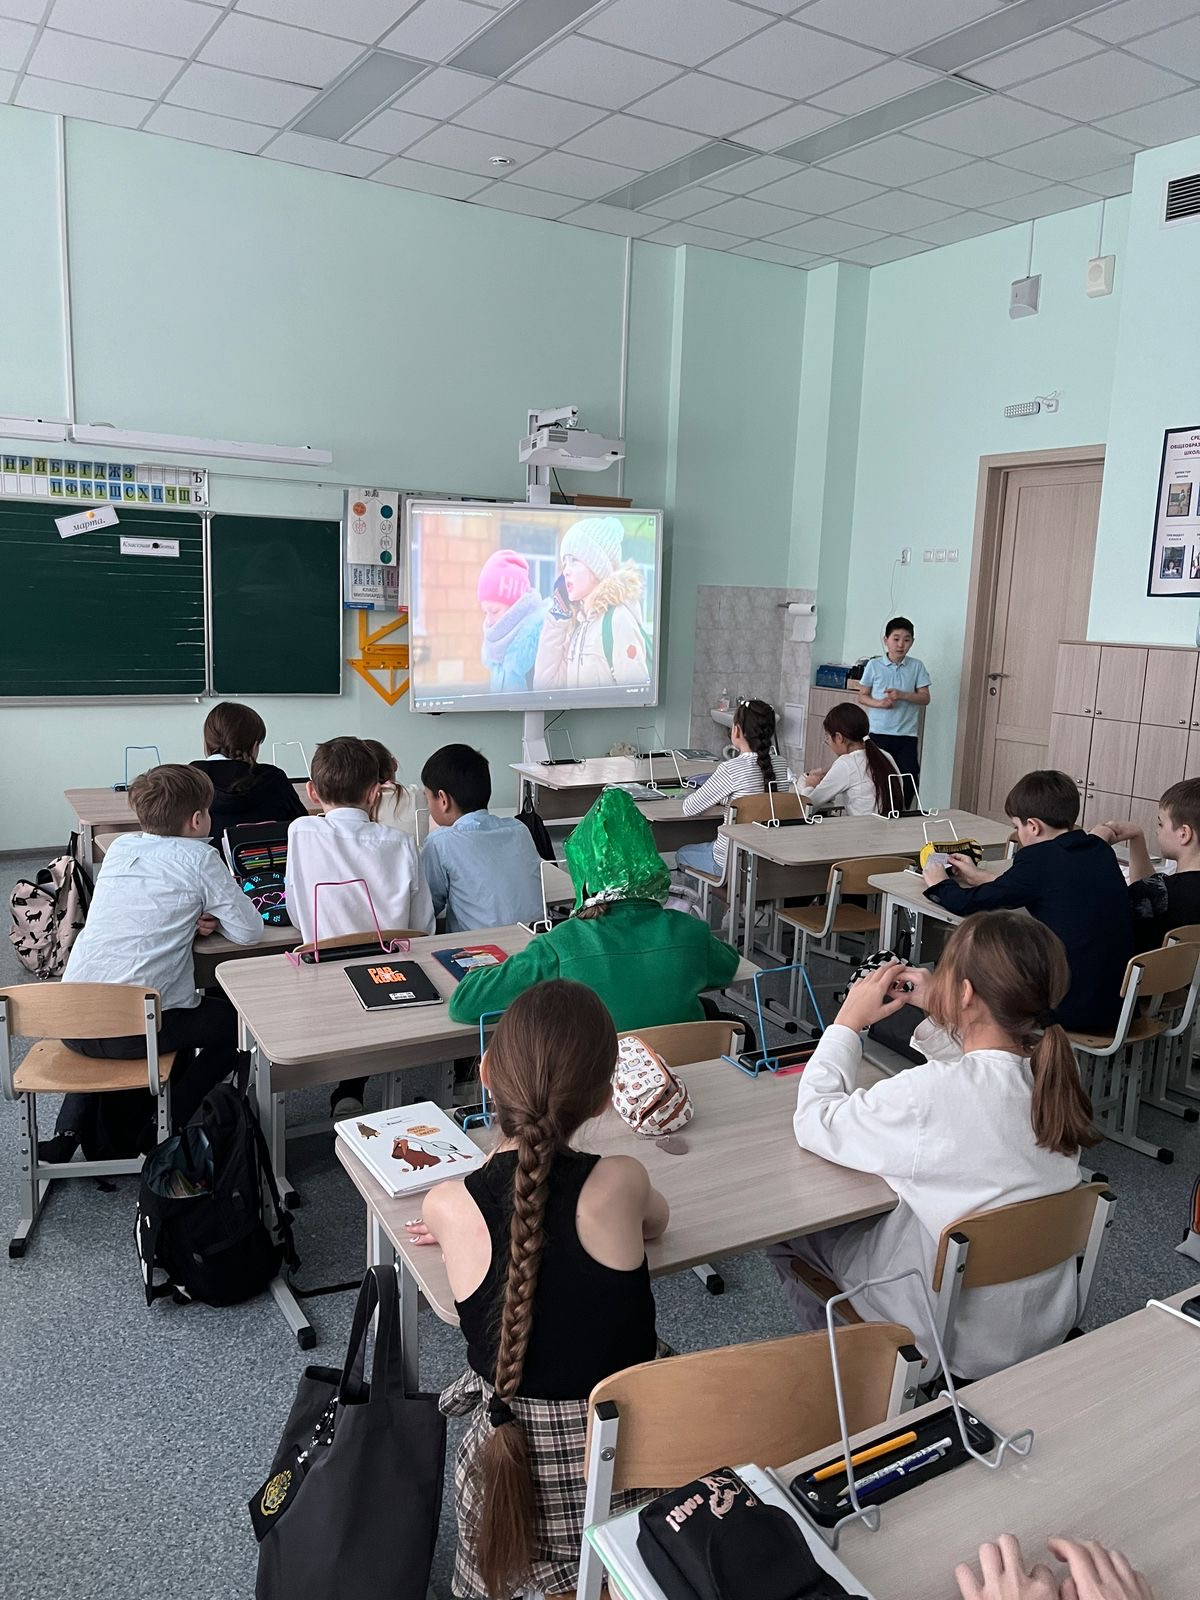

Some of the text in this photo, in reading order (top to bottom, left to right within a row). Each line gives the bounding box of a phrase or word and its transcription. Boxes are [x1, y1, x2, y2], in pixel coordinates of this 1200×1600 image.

[5, 457, 203, 484] Н Р Й Б В Г Д Ж З Ъ
[50, 481, 61, 493] П
[66, 482, 77, 494] Ф
[82, 483, 92, 496] К
[96, 484, 105, 496] Т
[110, 485, 121, 497] Ш
[125, 486, 134, 498] С
[139, 487, 149, 499] Х
[153, 487, 163, 502] Ц
[166, 489, 176, 501] Ч
[194, 491, 202, 502] Ь
[72, 518, 106, 532] марта.
[665, 1493, 705, 1533] ROAR!
